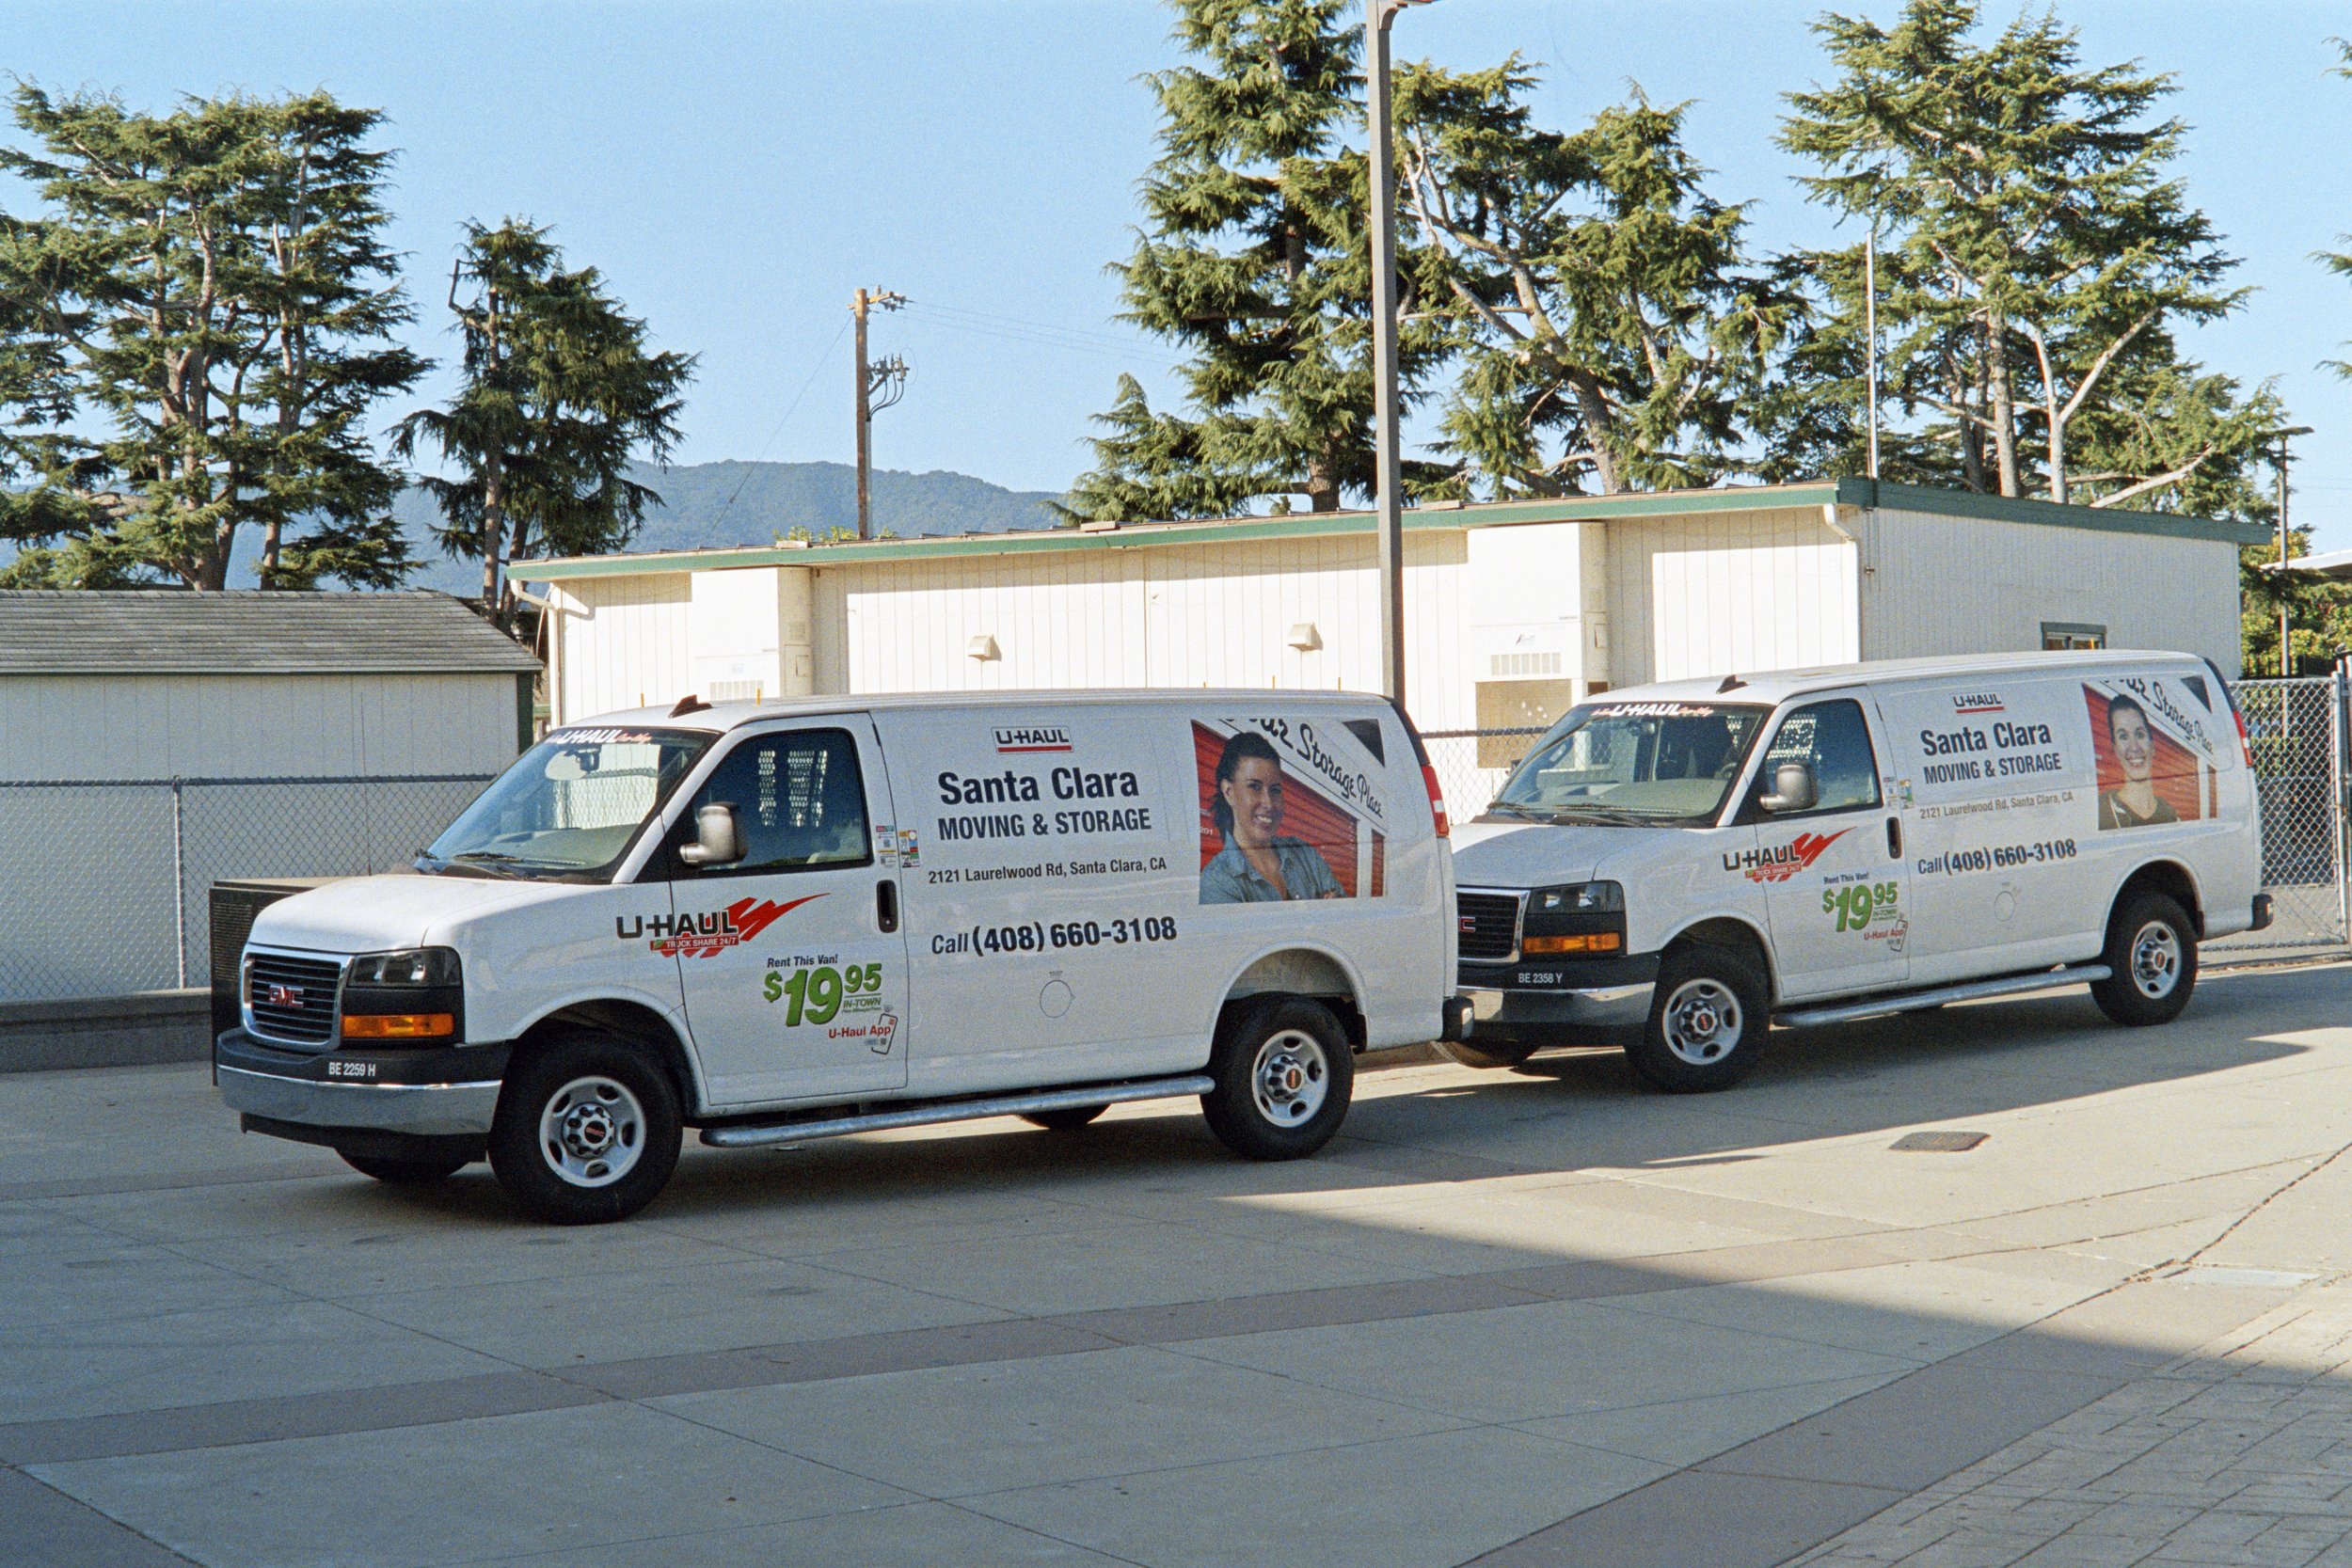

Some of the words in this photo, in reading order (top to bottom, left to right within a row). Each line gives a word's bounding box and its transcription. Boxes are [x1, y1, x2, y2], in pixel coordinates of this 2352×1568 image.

[1609, 704, 1681, 716] U-HAUL
[1953, 693, 2002, 707] U-HAUL
[2153, 681, 2196, 740] Storage
[557, 729, 622, 745] U-HAUL
[995, 729, 1070, 745] U-HAUL
[1920, 728, 1987, 756] Santa
[1993, 722, 2052, 749] Clara
[1296, 723, 1357, 800] Storage
[1357, 773, 1383, 818] Place
[1924, 761, 1980, 784] MOVING
[1985, 760, 1996, 777] &
[1999, 752, 2062, 776] STORAGE
[938, 770, 1041, 805] Santa
[1051, 767, 1139, 800] Clara
[1920, 807, 1942, 819] 2121
[1944, 800, 1994, 817] Laurelwood
[1995, 798, 2010, 812] Rd,
[2010, 795, 2035, 808] Santa
[2037, 793, 2060, 806] Clara,
[2062, 791, 2074, 802] CA
[938, 814, 1025, 841] MOVING
[1033, 813, 1048, 835] &
[1057, 808, 1152, 834] STORAGE
[1723, 844, 1800, 871] U-HAUL
[1917, 857, 1943, 876] Call
[1944, 846, 1991, 876] (408)
[1994, 838, 2077, 867] 660-3108
[929, 868, 961, 884] 2121
[965, 865, 1042, 881] Laurelwood
[1046, 863, 1068, 879] Rd,
[1071, 861, 1106, 876] Santa
[1110, 858, 1147, 875] Clara,
[1150, 857, 1168, 871] CA
[1823, 875, 1839, 884] Rent
[1840, 873, 1854, 882] This
[616, 911, 739, 939] U-HAUL
[931, 933, 968, 955] Call
[972, 921, 1044, 957] (408)
[1050, 916, 1177, 949] 660-3108
[1864, 930, 1888, 941] U-Haul
[1890, 928, 1904, 938] App
[666, 940, 691, 948] TRUCK
[692, 938, 718, 947] SHARE
[720, 937, 737, 946] 24/7
[767, 958, 790, 968] Rent
[794, 956, 815, 967] This
[817, 954, 838, 965] Van!
[1518, 973, 1531, 983] BE
[1533, 973, 1554, 984] 2358
[1555, 973, 1563, 984] Y
[269, 984, 304, 1007] GMC
[843, 997, 882, 1008] IN-TOWN
[828, 1025, 866, 1038] U-Haul
[870, 1024, 891, 1037] App
[329, 1062, 342, 1075] BE
[343, 1063, 366, 1076] 2259
[368, 1064, 376, 1077] H
